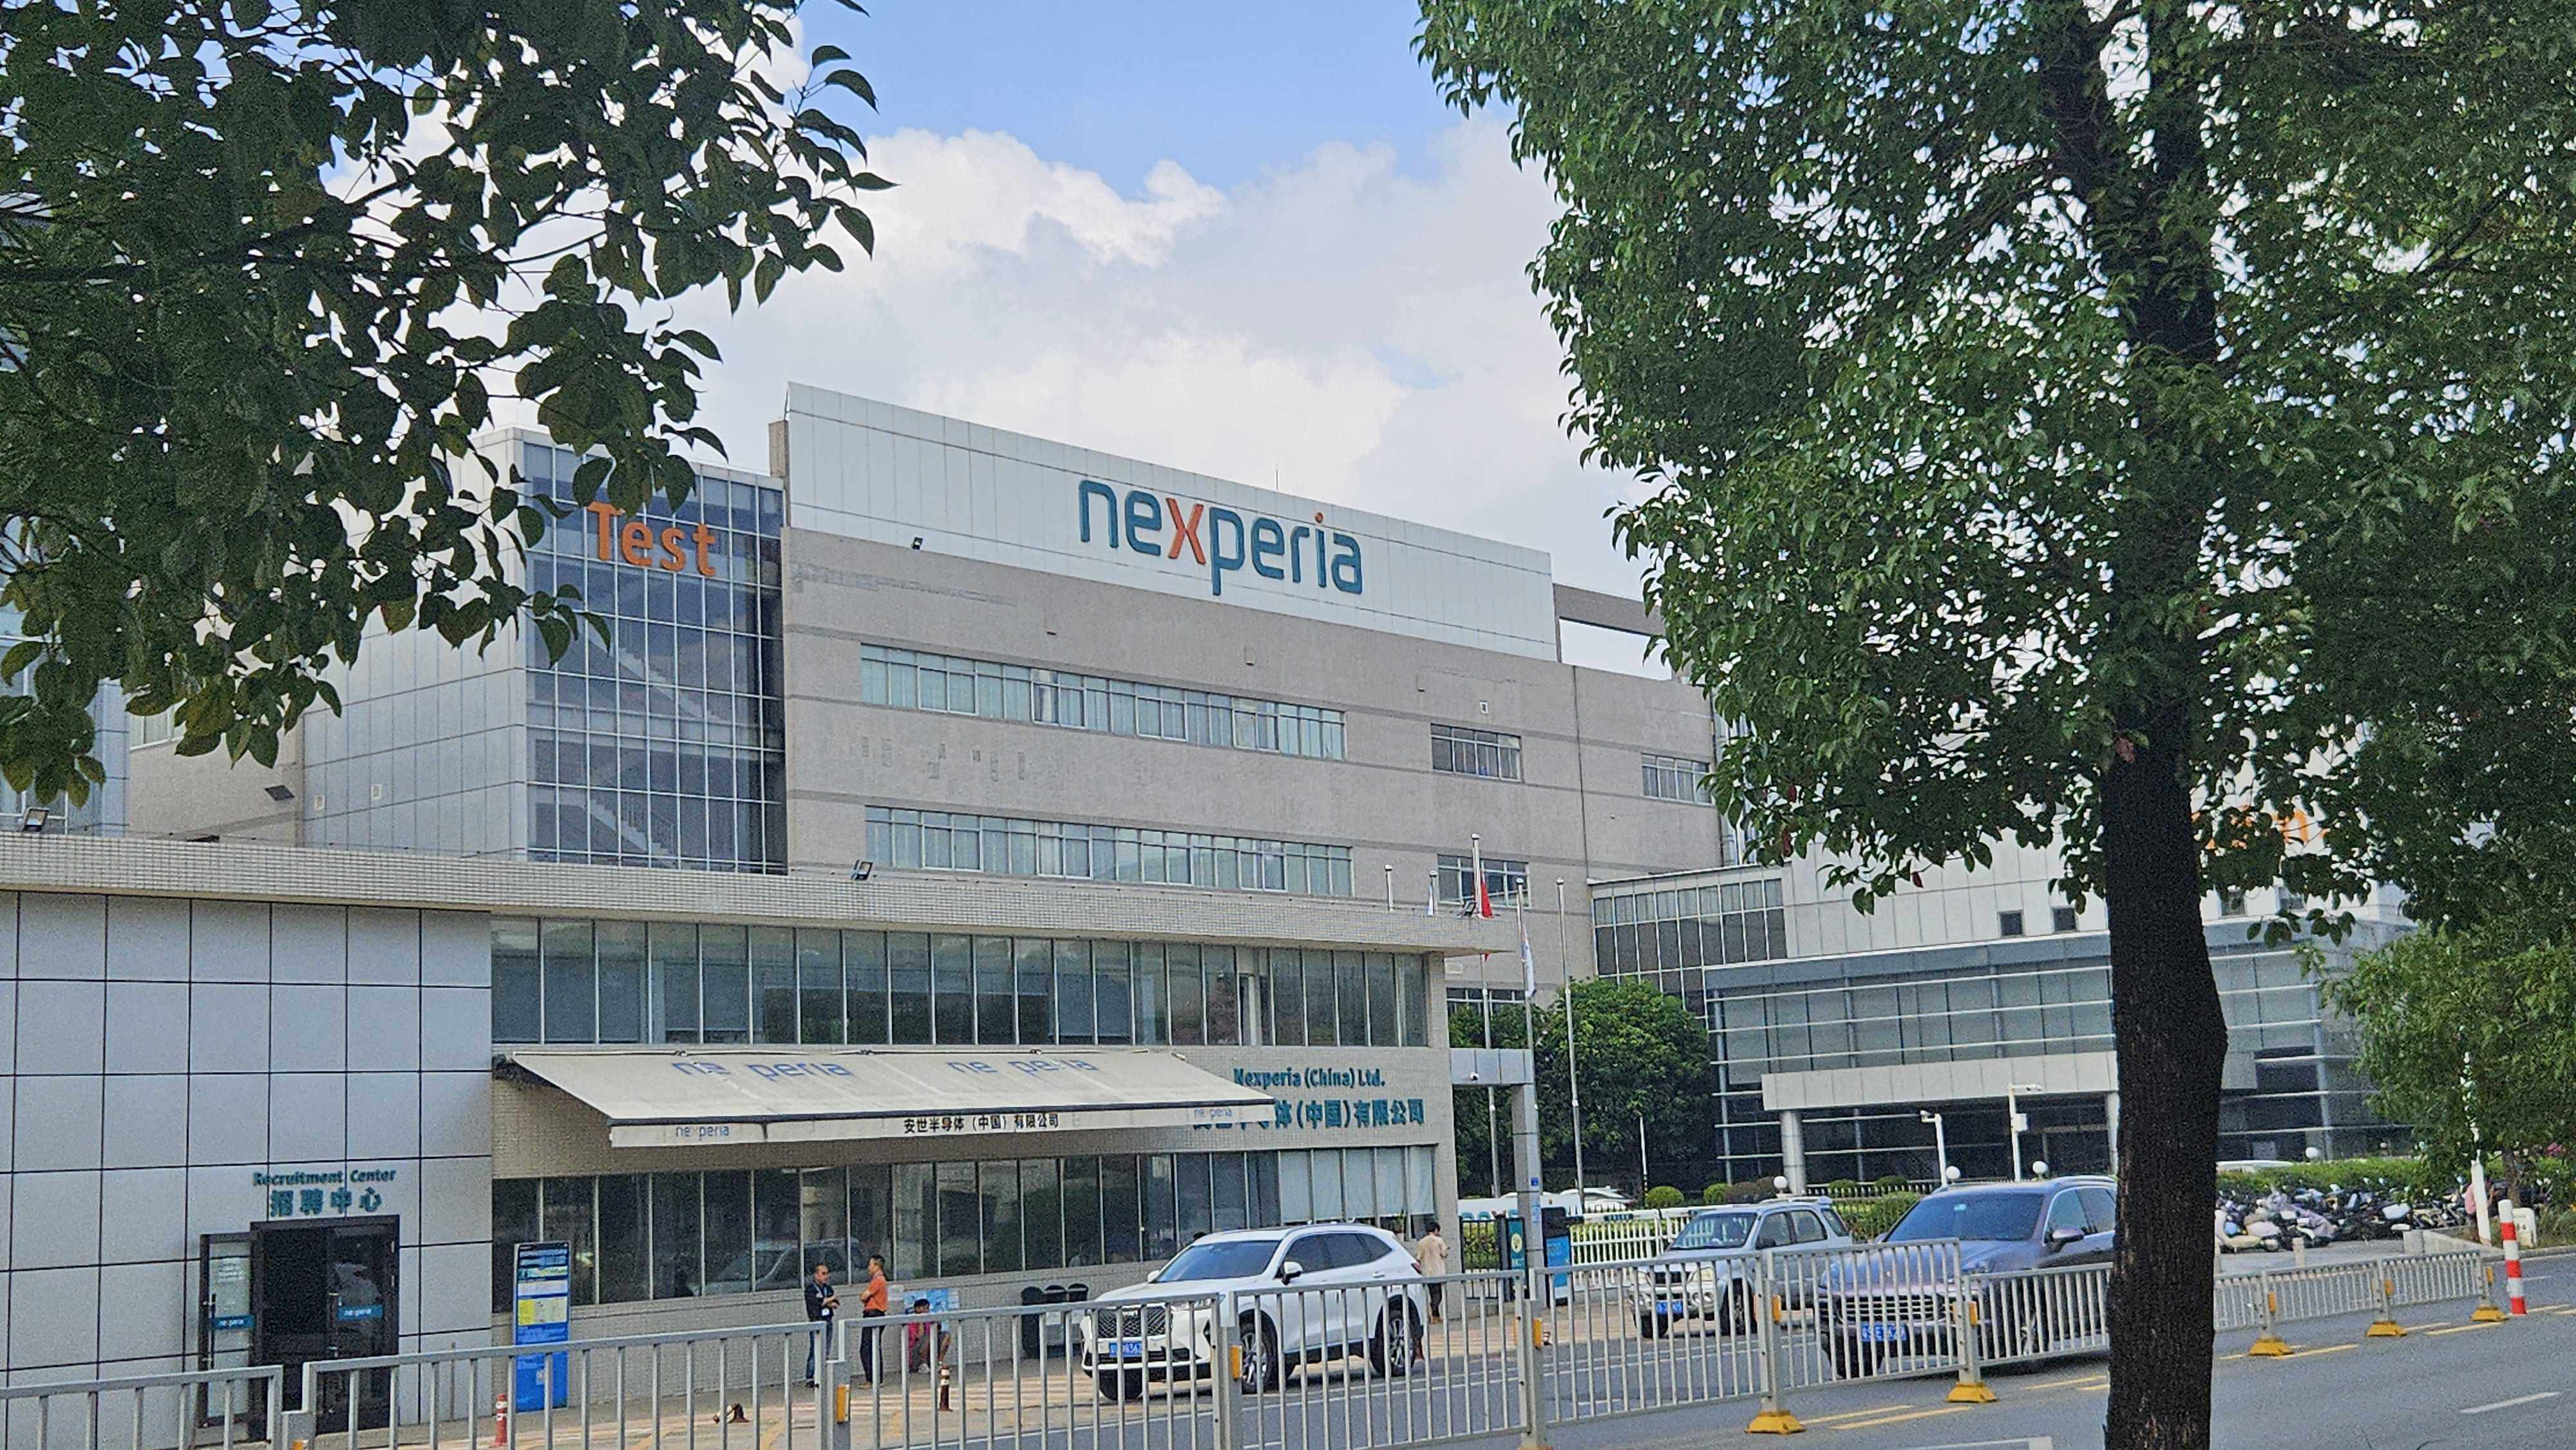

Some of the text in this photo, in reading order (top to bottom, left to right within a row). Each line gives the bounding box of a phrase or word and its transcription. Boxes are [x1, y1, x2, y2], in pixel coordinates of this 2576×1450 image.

[587, 501, 716, 577] Test
[1078, 480, 1363, 596] nexperia
[1233, 1067, 1386, 1089] Nexperia (China) Ltd.
[904, 1113, 1059, 1134] 安世半导体（中国）有限公司
[1193, 1098, 1425, 1130] 体（中国）有限公司
[252, 1169, 397, 1187] Recruitment Center
